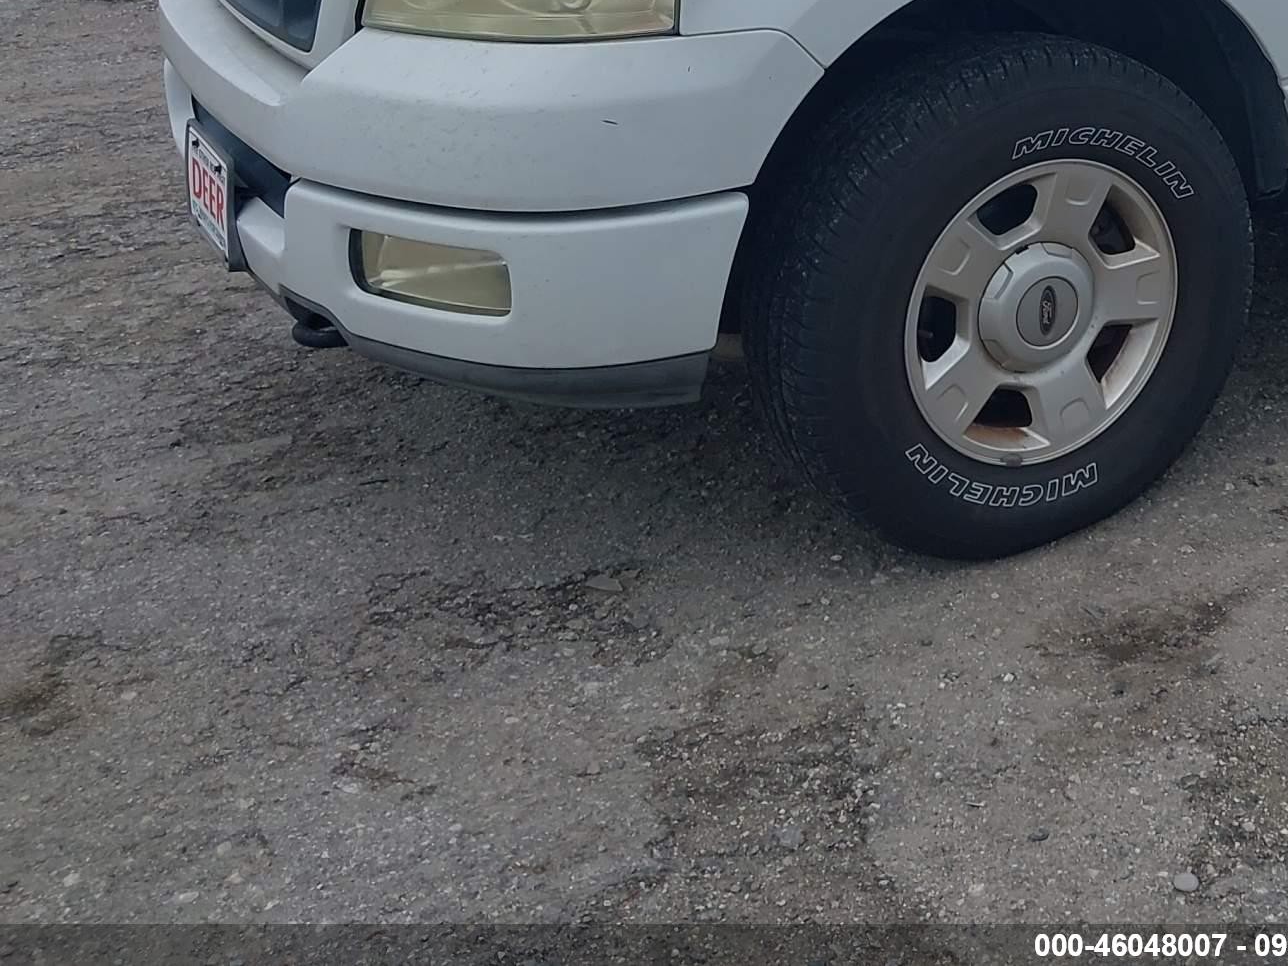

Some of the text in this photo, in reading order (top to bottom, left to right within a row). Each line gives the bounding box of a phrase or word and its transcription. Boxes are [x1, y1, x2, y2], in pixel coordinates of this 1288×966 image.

[191, 156, 225, 232] DEER
[1012, 126, 1195, 200] MICHELIN
[905, 442, 1099, 507] MICHELIN
